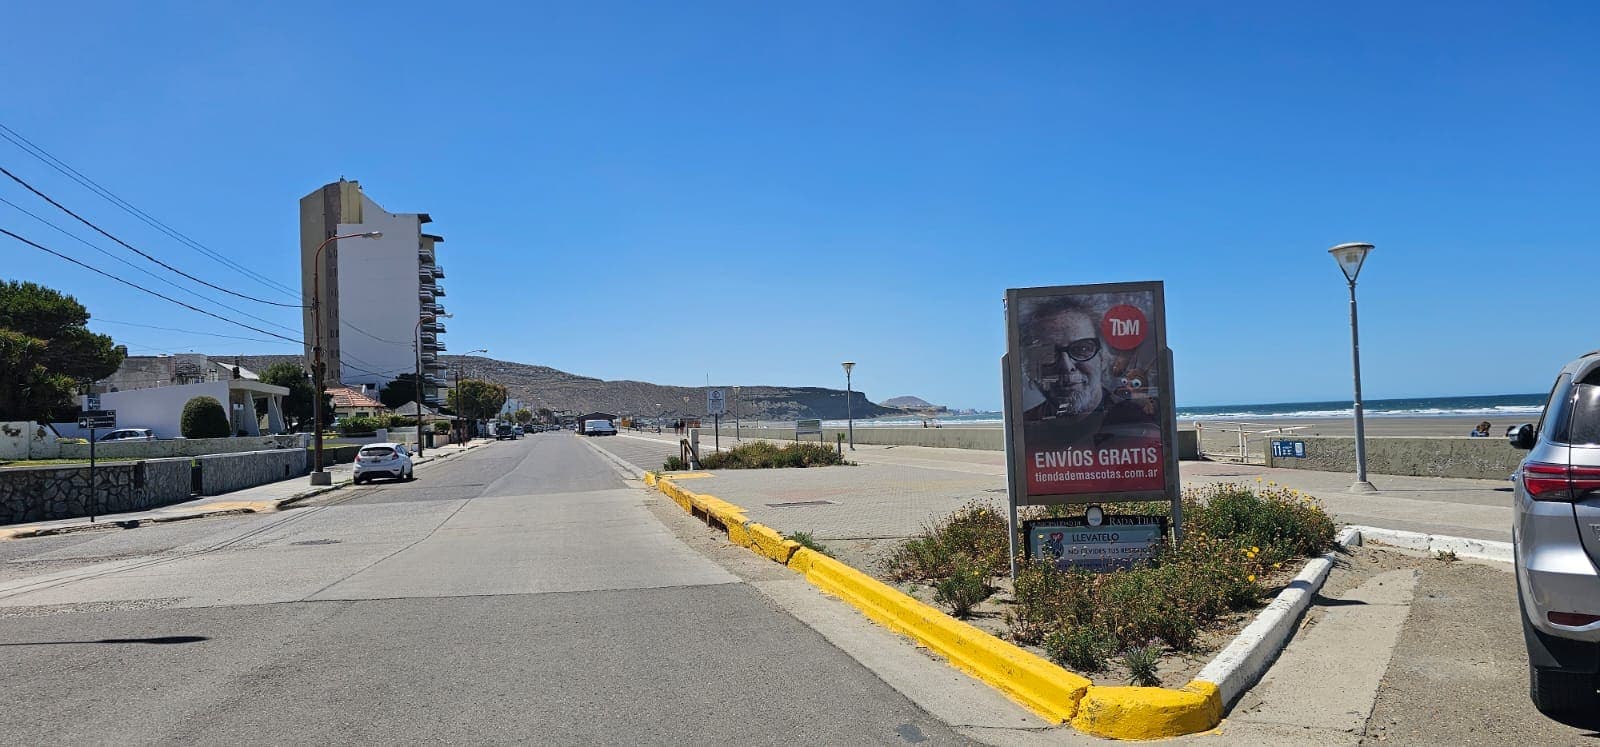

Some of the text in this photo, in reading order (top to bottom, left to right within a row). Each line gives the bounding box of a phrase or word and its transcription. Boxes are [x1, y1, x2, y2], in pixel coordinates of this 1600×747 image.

[1109, 318, 1140, 337] TDM
[1035, 446, 1158, 468] ENVÍOS GRATIS
[1035, 468, 1158, 483] tiendademascotas.com.ar
[1071, 532, 1120, 542] LLEVATELO
